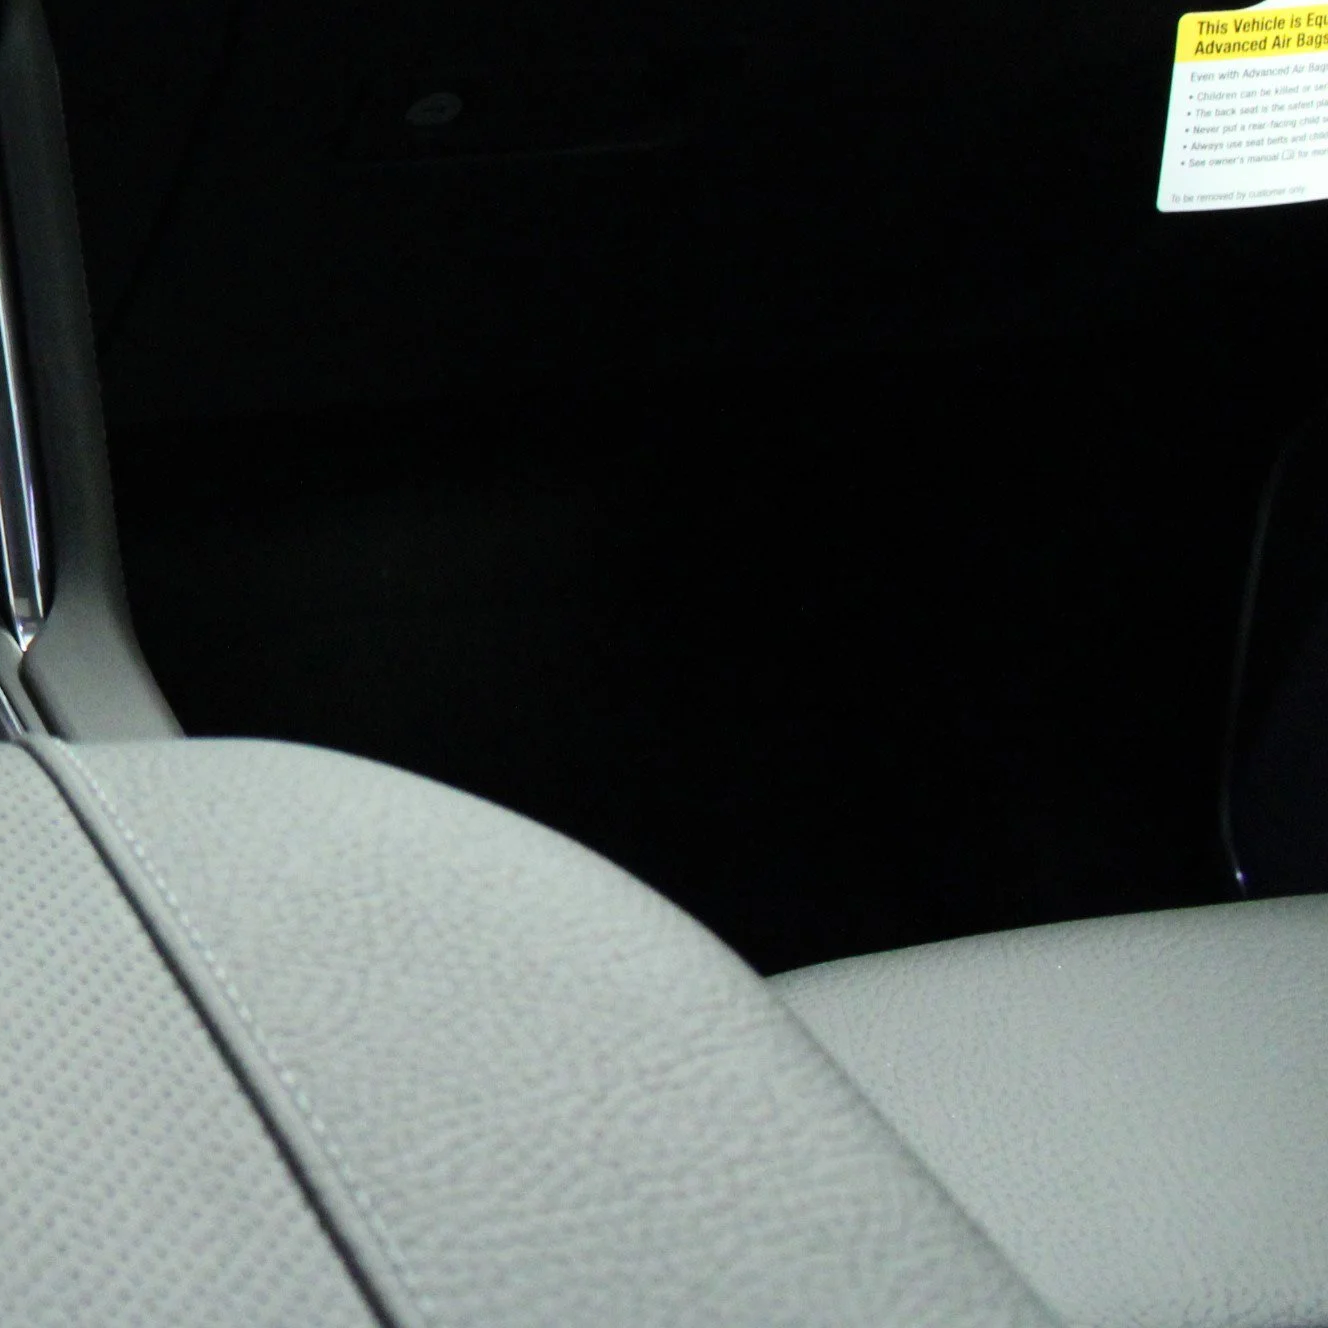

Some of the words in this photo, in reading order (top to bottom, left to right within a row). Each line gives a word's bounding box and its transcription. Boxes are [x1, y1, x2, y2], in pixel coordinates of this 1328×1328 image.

[1197, 20, 1228, 35] This
[1233, 16, 1285, 34] Vehicle
[1290, 15, 1302, 29] is
[1194, 36, 1267, 55] Advanced
[1272, 35, 1292, 50] Air
[1190, 71, 1214, 83] Even
[1218, 68, 1239, 81] with
[1242, 65, 1290, 79] Advanced
[1196, 89, 1237, 102] Children
